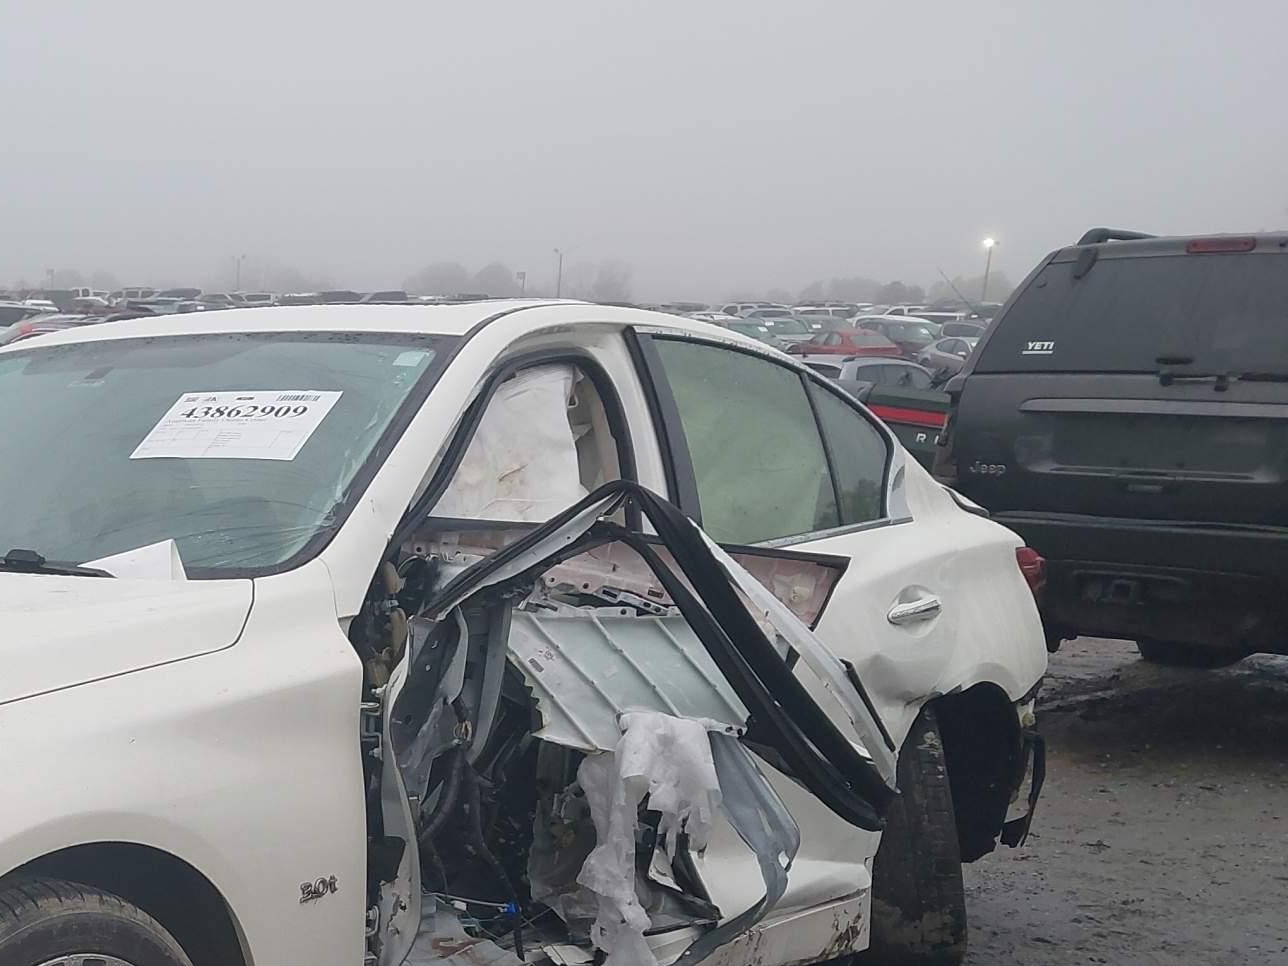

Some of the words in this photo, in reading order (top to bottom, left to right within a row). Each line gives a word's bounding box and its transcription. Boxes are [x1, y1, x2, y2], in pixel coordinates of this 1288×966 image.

[1027, 341, 1055, 350] YETI
[181, 405, 308, 419] 43862909
[969, 460, 1007, 477] Jeep
